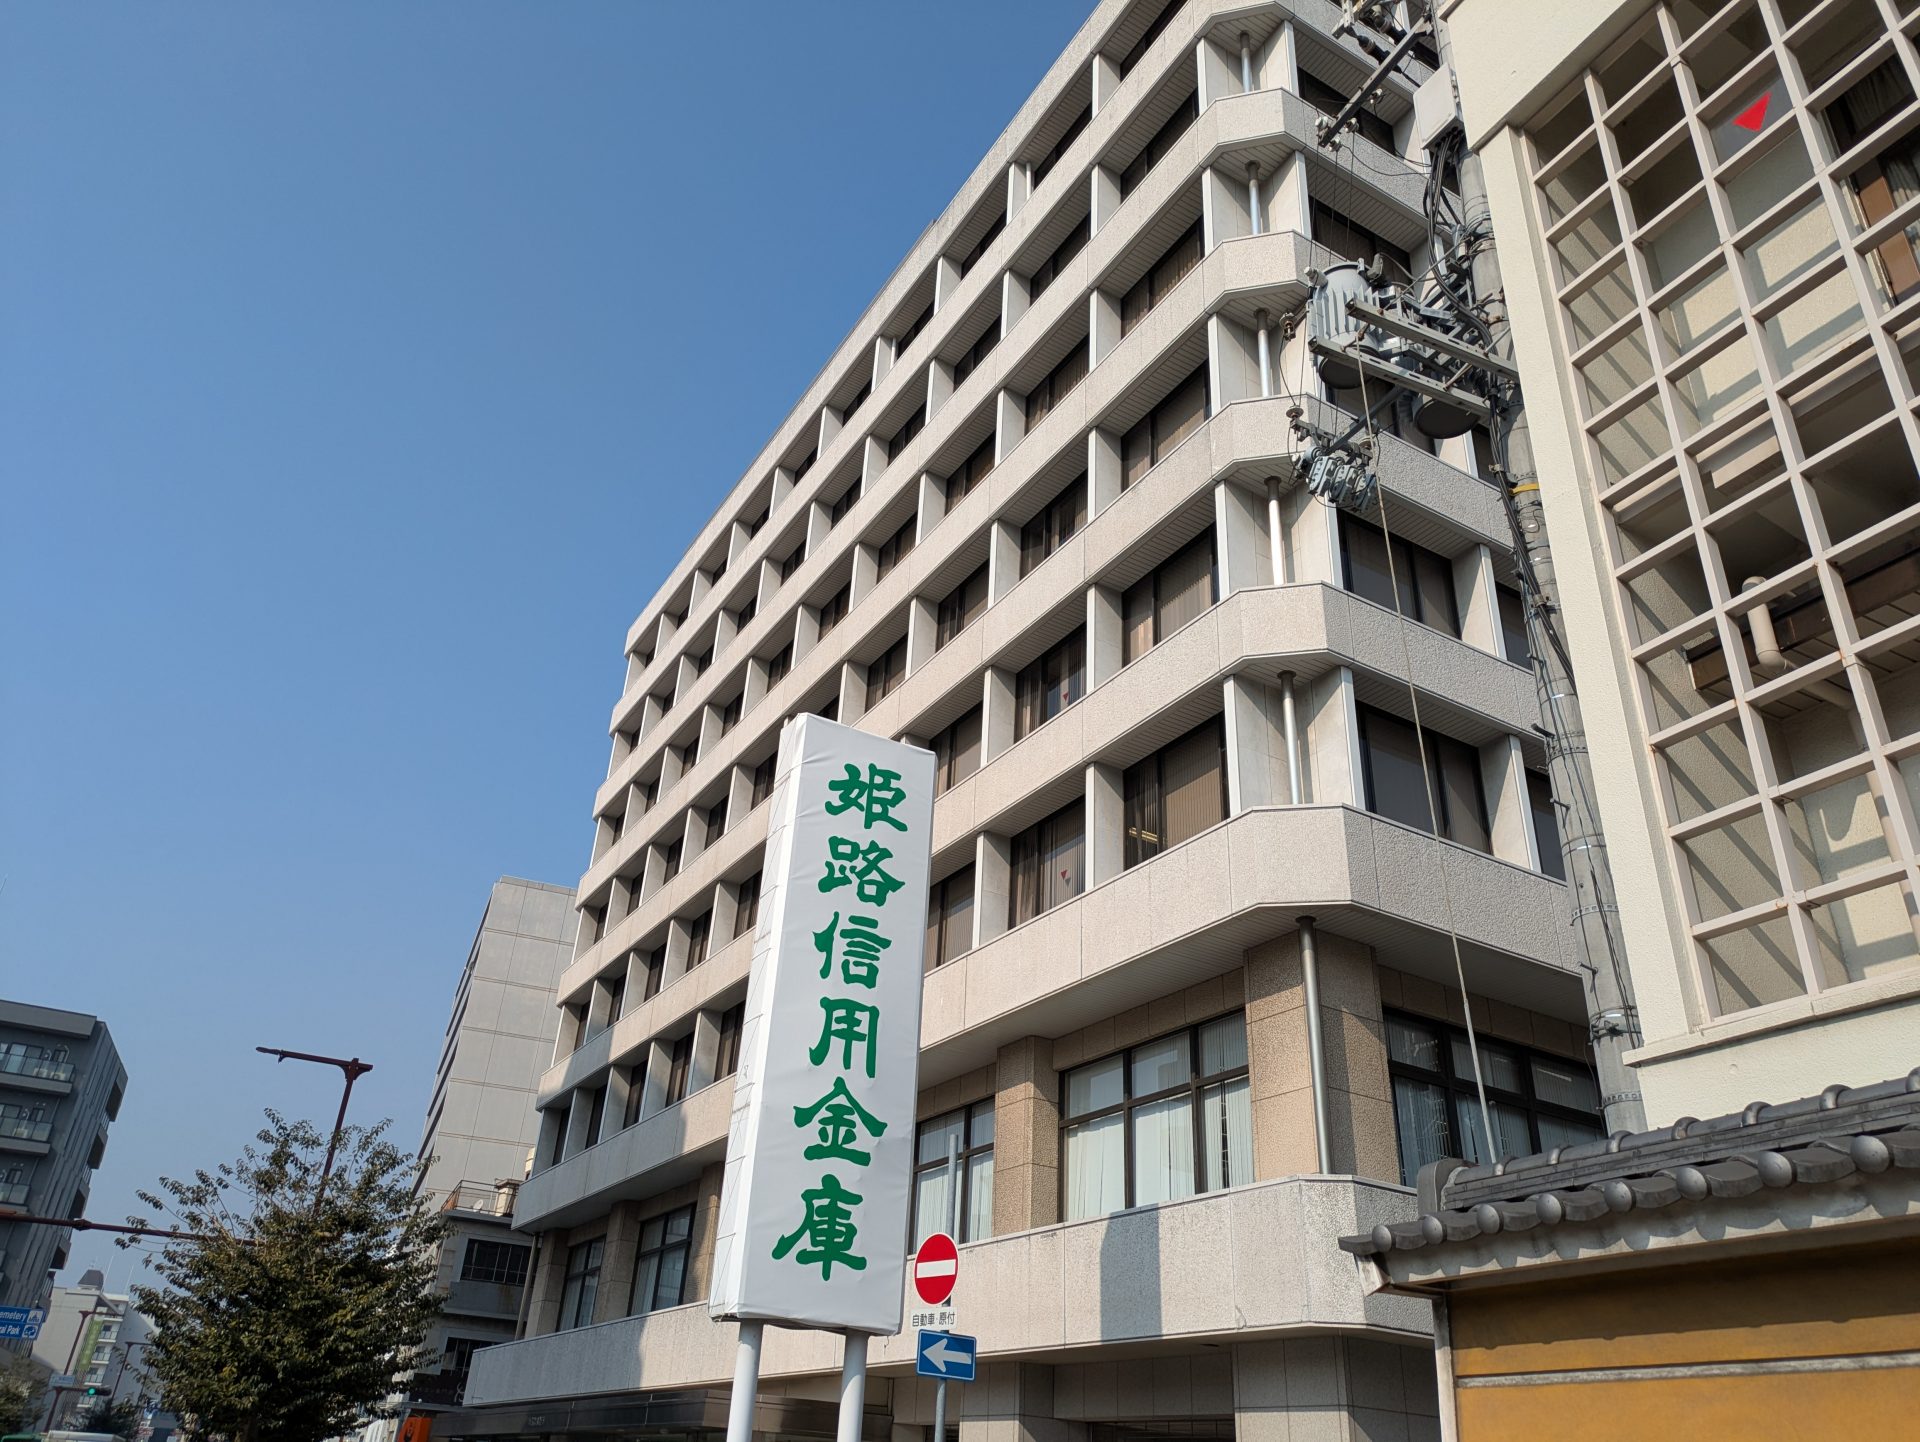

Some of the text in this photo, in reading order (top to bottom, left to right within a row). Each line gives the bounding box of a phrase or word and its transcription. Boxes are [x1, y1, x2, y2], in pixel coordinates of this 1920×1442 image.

[772, 763, 907, 1280] 姫路信用金庫
[7, 1325, 20, 1335] Park
